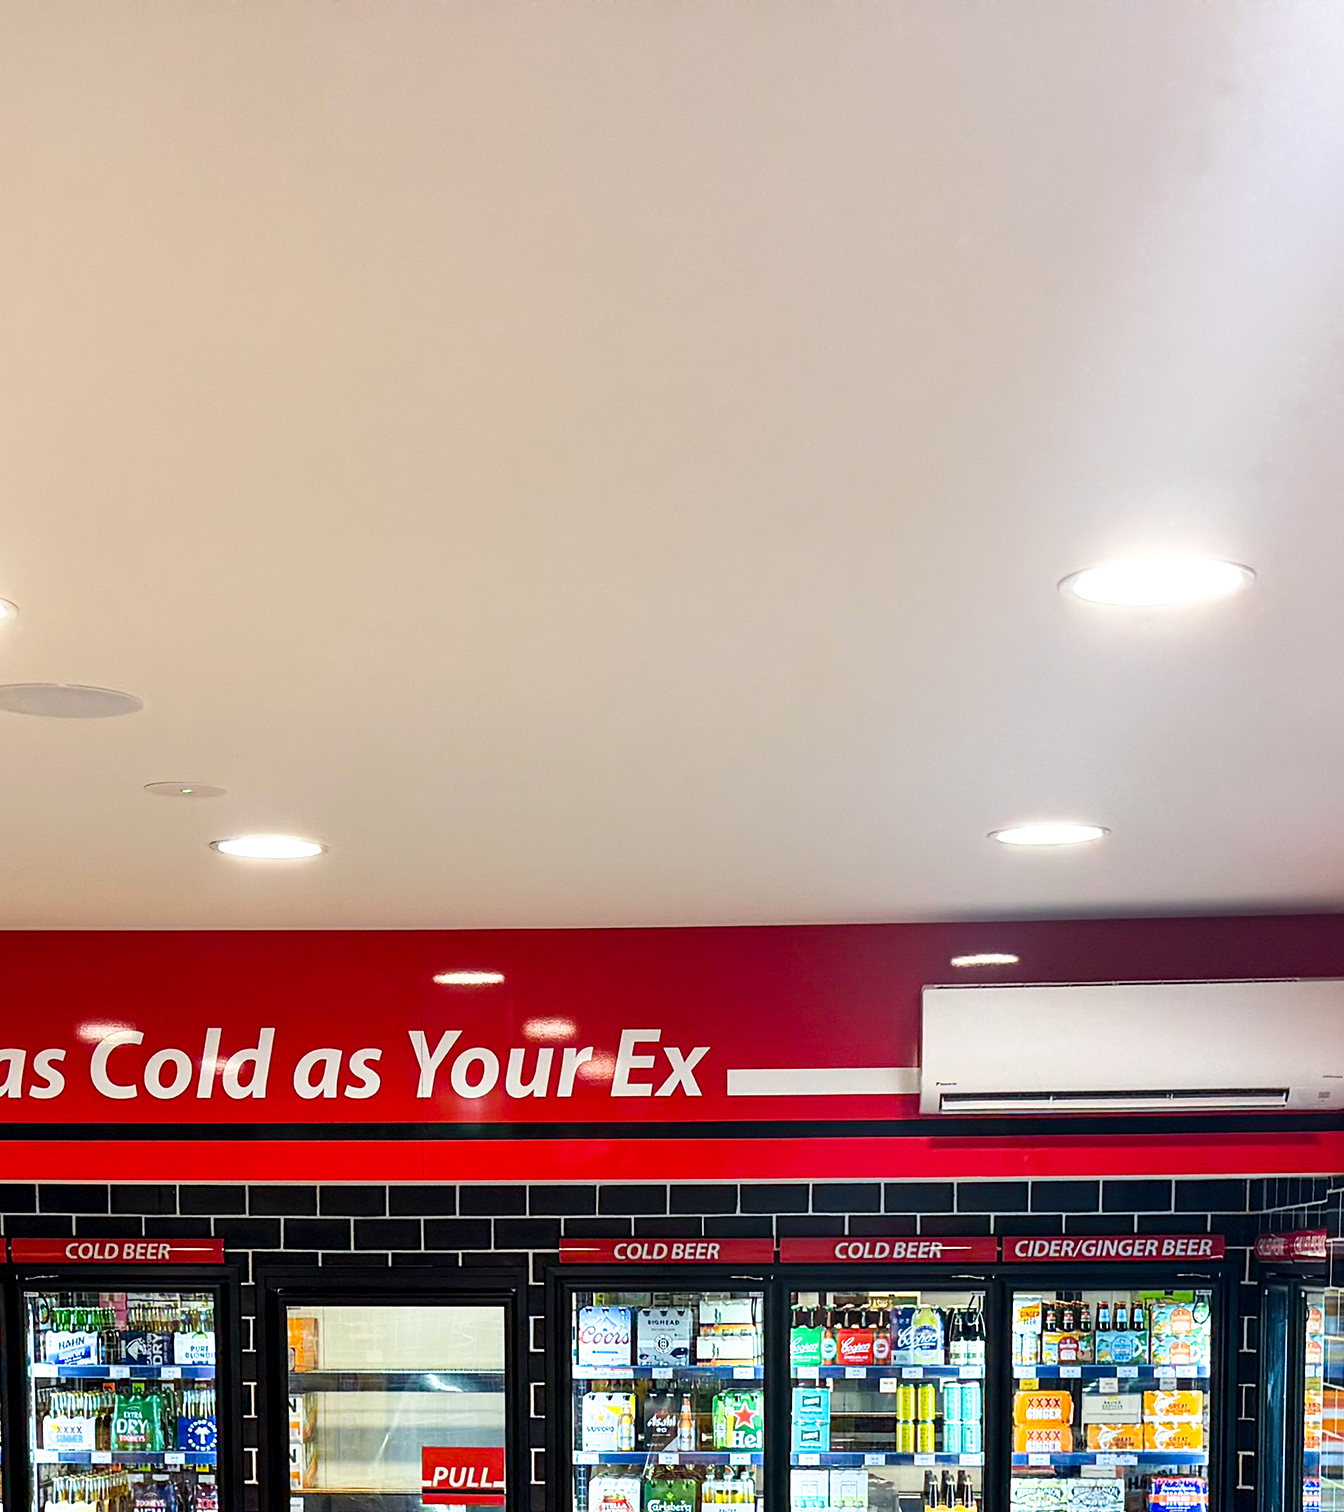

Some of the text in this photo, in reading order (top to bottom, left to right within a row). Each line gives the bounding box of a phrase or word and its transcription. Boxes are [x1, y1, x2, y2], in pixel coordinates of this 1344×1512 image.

[90, 1027, 276, 1099] Cold
[294, 1047, 383, 1100] as
[408, 1029, 594, 1100] Your
[611, 1029, 710, 1097] Ex
[65, 1243, 170, 1260] COLD BEER
[614, 1243, 720, 1260] COLD BEER
[835, 1242, 942, 1259] COLD BEER
[1014, 1240, 1212, 1257] CIDER/GINGER BEER
[578, 1326, 630, 1346] Coors
[1028, 1399, 1060, 1408] XXXX
[1026, 1409, 1062, 1420] GINGER
[116, 1419, 147, 1434] DRY
[432, 1468, 492, 1487] PULL
